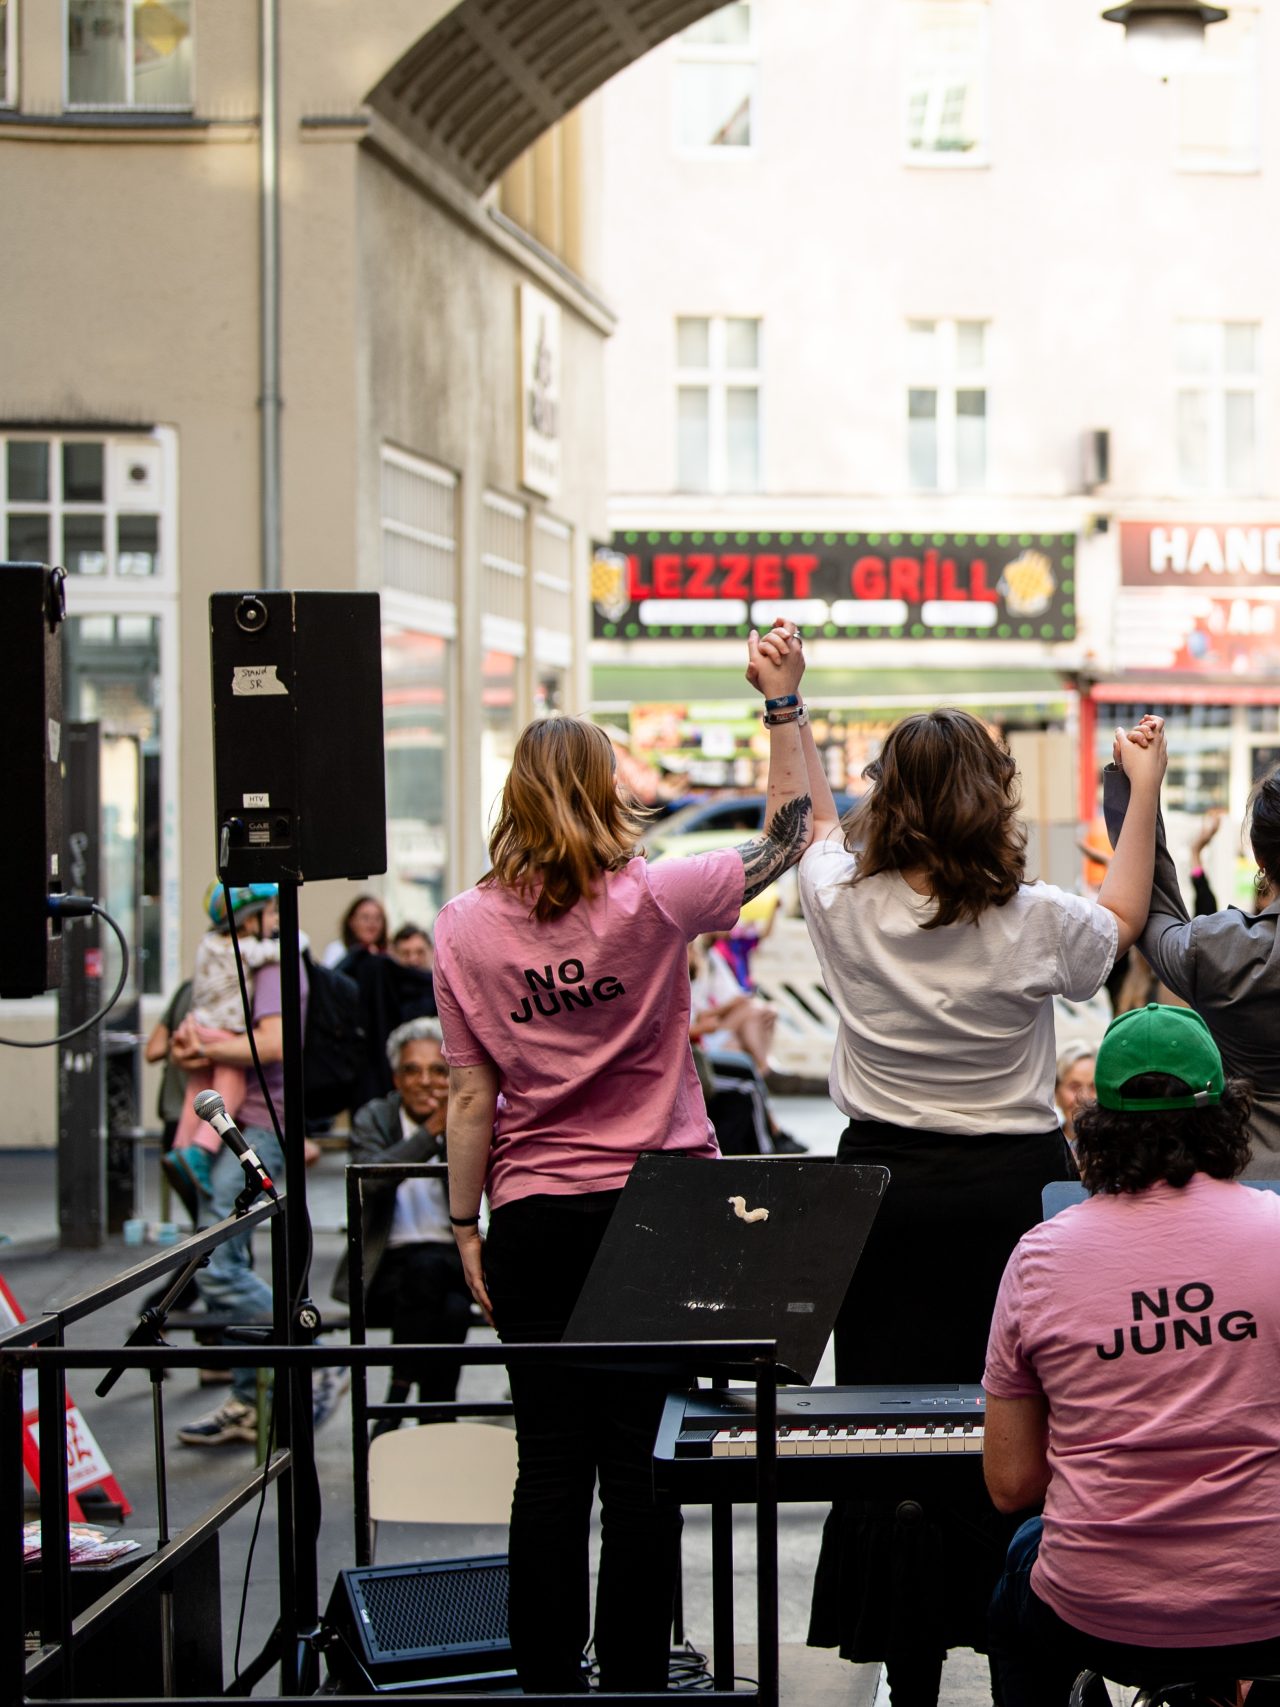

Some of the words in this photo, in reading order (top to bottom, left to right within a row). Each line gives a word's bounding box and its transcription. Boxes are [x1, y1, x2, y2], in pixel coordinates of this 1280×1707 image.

[626, 553, 819, 600] LEZZET
[524, 958, 585, 992] NO
[510, 976, 626, 1024] JUNG
[1131, 1281, 1214, 1321] NO
[1096, 1310, 1258, 1361] JUNG
